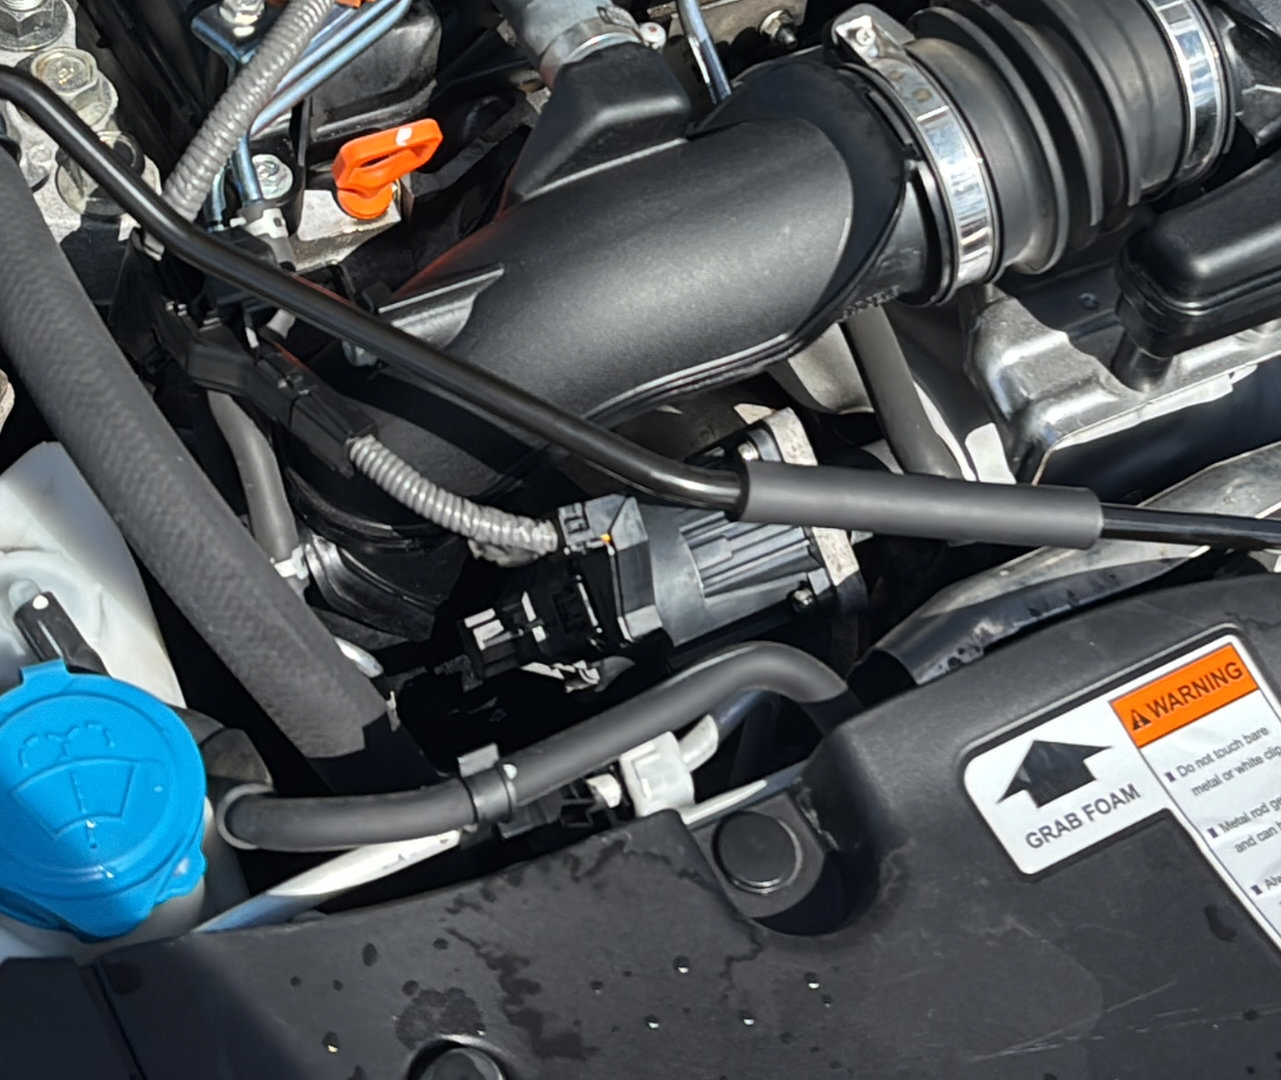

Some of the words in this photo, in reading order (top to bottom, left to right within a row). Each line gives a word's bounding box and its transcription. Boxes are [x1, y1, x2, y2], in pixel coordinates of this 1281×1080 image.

[1146, 661, 1244, 719] WARNING
[1176, 764, 1196, 778] Do
[1195, 754, 1215, 770] not
[1213, 739, 1244, 761] touch
[1243, 726, 1270, 744] bare
[1191, 775, 1223, 796] metal
[1222, 769, 1234, 782] or
[1234, 755, 1264, 775] white
[1025, 812, 1083, 849] GRAB
[1081, 783, 1142, 822] FOAM
[1219, 812, 1251, 834] Metal
[1250, 802, 1270, 820] rod
[1234, 835, 1257, 853] and
[1256, 827, 1278, 842] can
